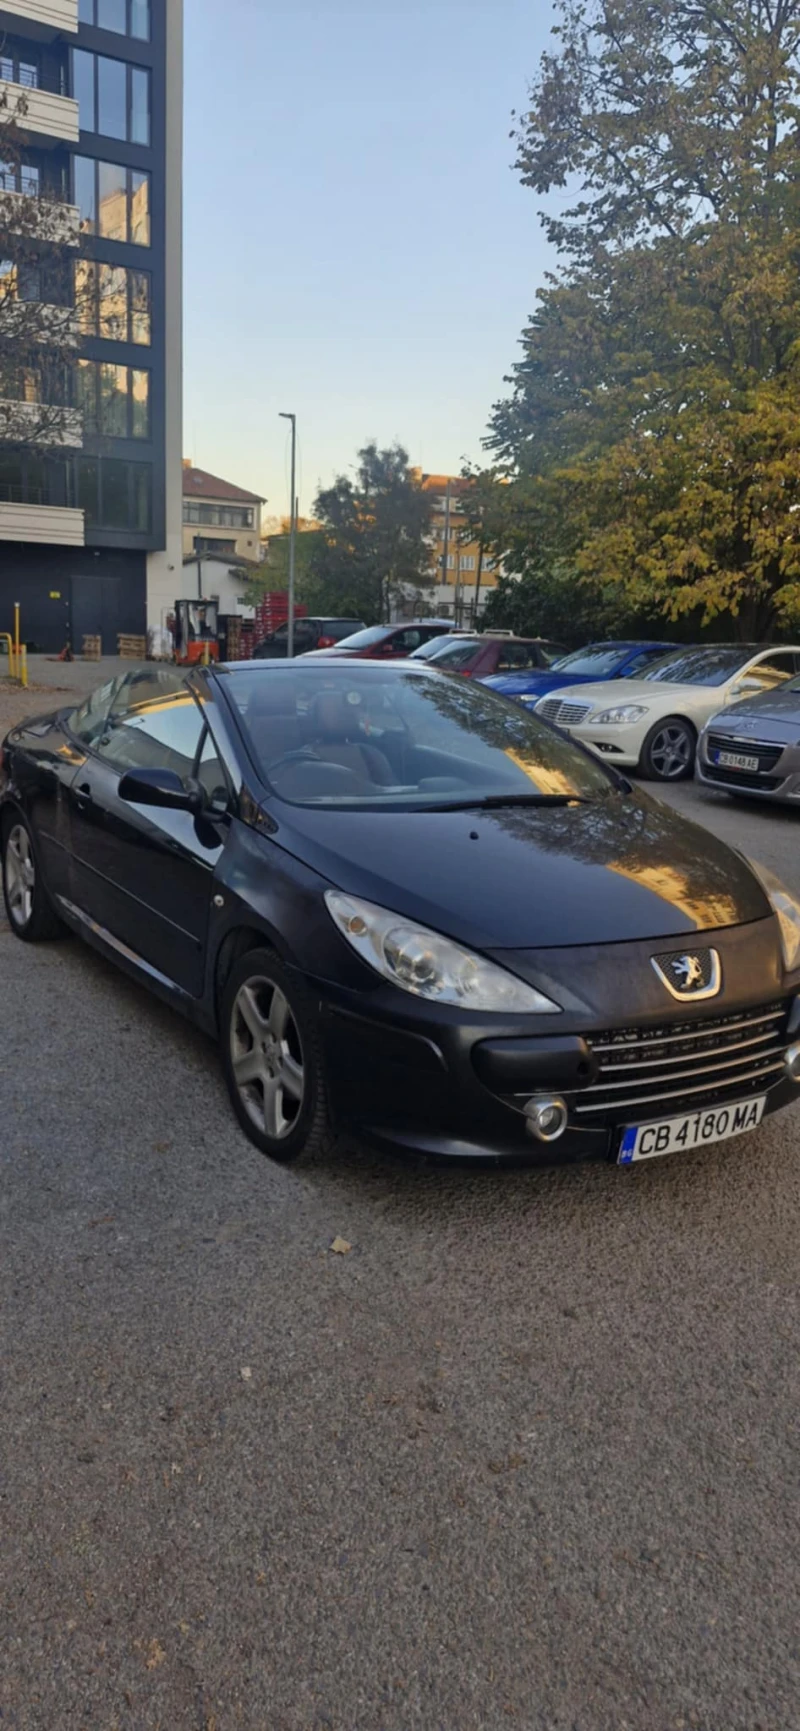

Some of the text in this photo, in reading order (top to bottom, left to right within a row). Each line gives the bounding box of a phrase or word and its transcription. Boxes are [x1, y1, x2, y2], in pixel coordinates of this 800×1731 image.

[638, 1102, 758, 1155] CB 4180 MA
